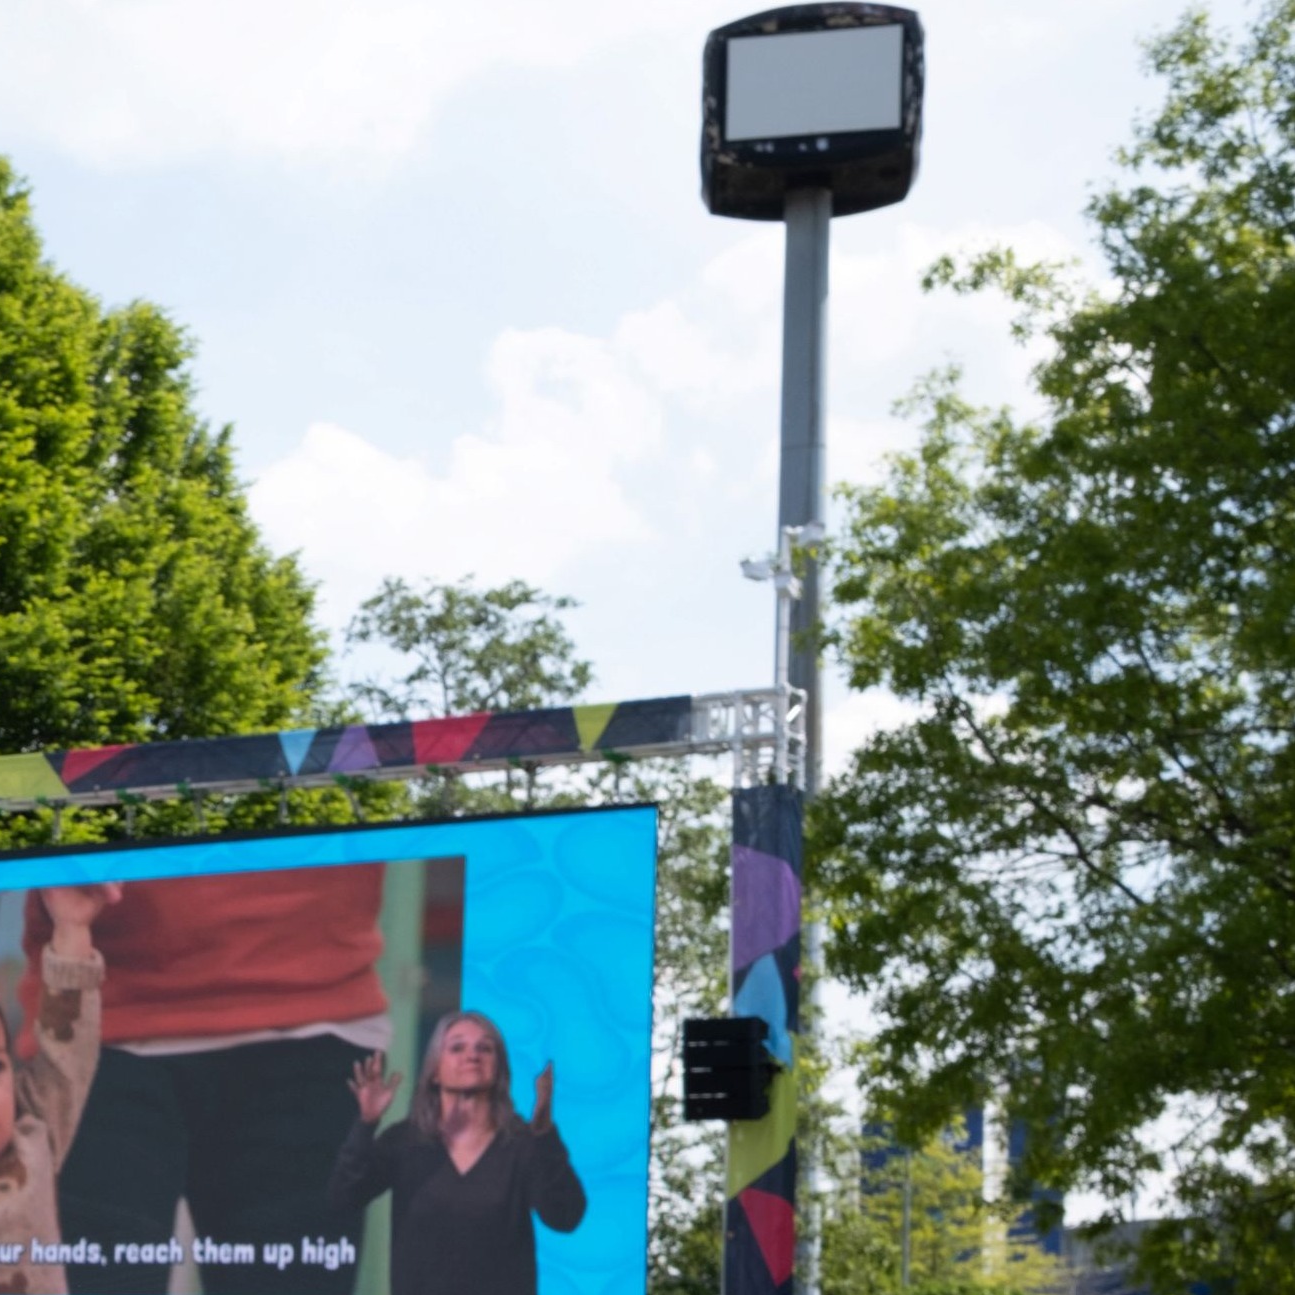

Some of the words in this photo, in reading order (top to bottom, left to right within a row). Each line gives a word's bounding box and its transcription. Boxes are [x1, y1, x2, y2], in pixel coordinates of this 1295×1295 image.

[31, 1237, 107, 1266] hands,
[114, 1237, 183, 1263] reach
[193, 1236, 255, 1263] them
[263, 1243, 294, 1270] up
[301, 1236, 355, 1270] high
